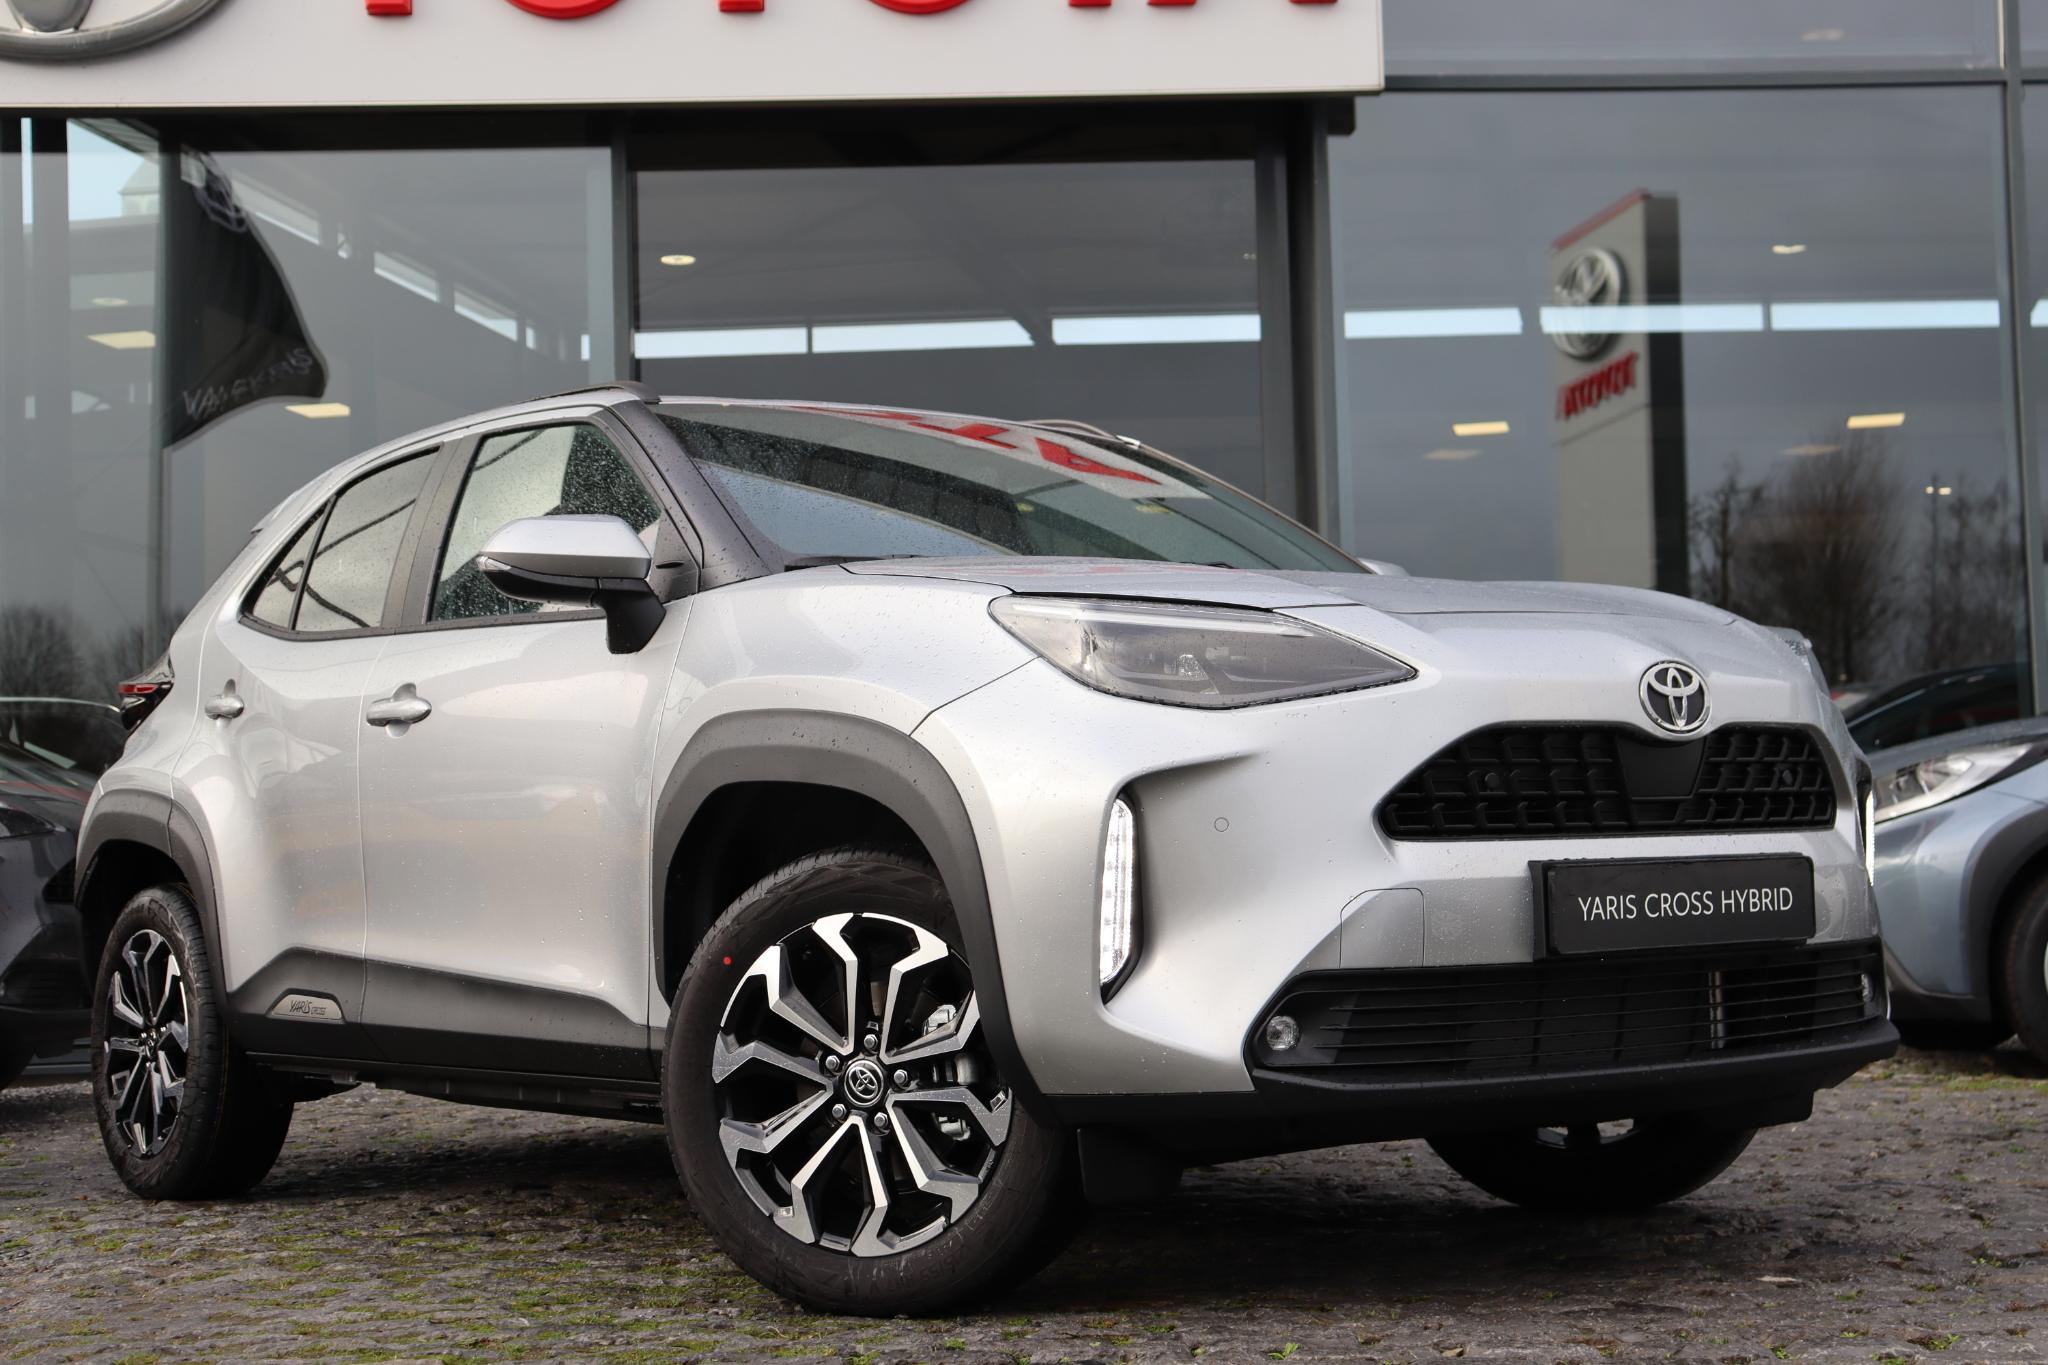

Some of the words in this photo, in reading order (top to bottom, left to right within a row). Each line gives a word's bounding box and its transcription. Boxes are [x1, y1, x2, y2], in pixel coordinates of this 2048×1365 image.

[1577, 894, 1637, 922] YARIS
[1644, 890, 1714, 918] CROSS
[1721, 887, 1794, 914] HYBRID
